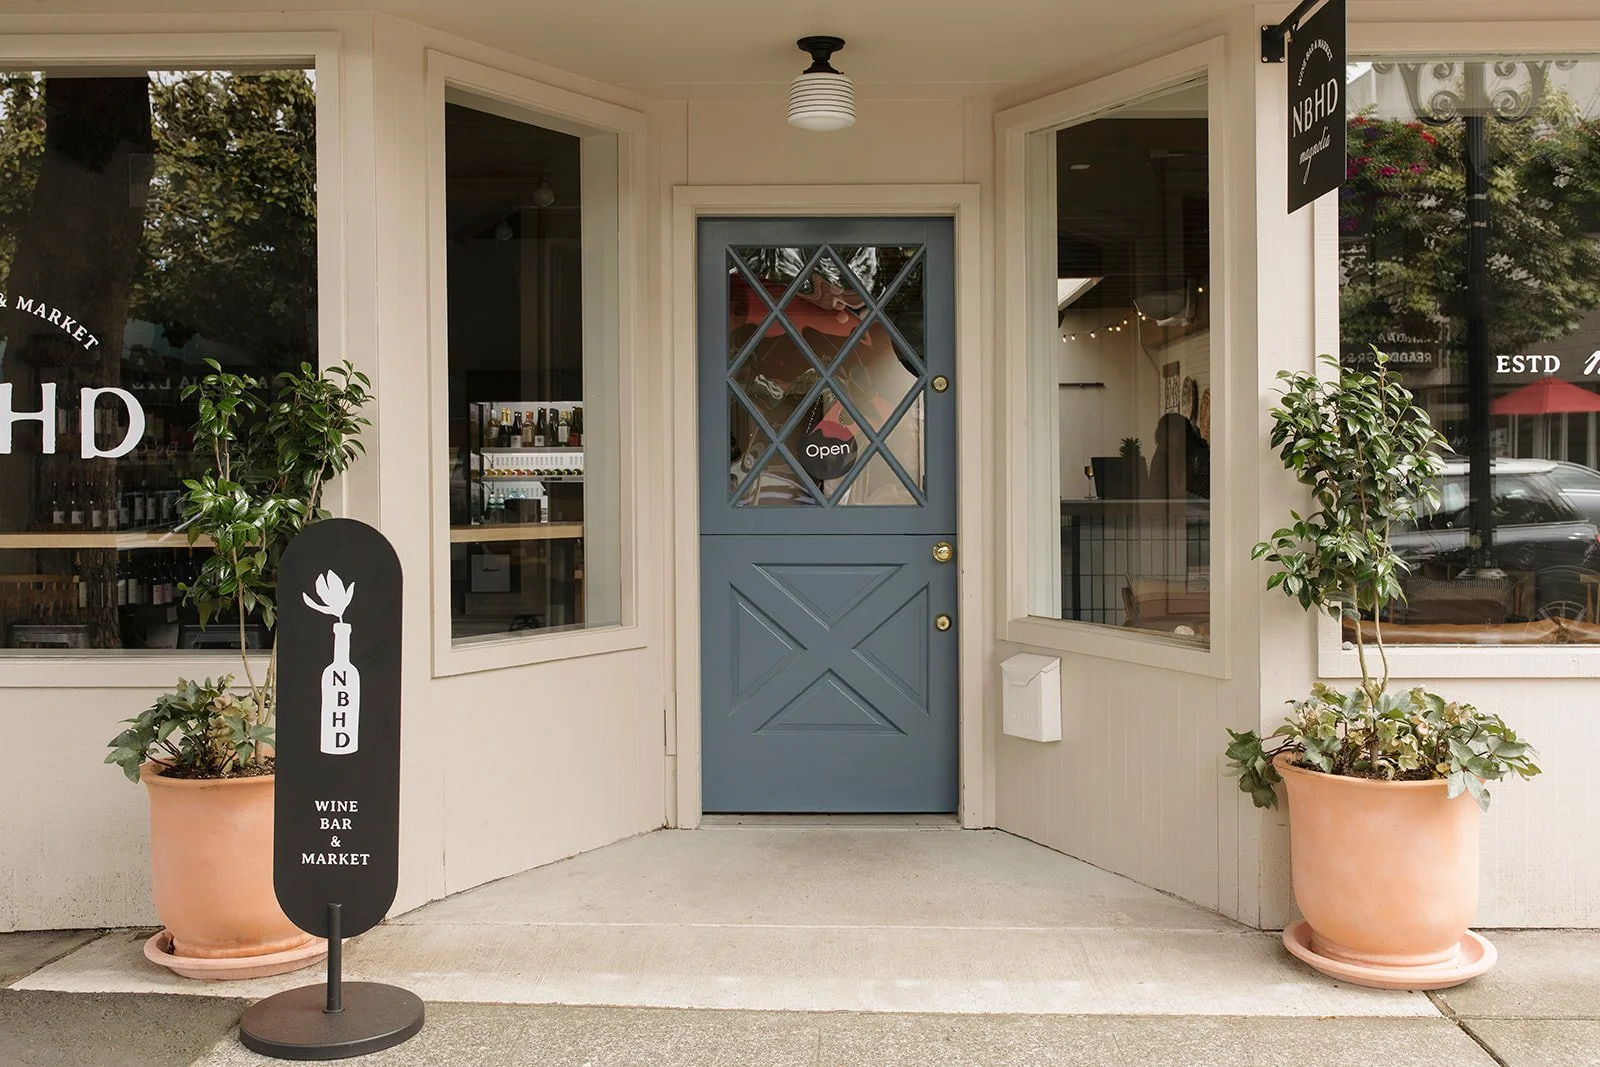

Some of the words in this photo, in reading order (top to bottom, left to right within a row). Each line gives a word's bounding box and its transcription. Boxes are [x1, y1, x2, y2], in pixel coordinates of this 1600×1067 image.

[1293, 78, 1338, 138] NBHD
[1299, 126, 1331, 185] magnolia
[15, 295, 100, 350] MARKET
[1496, 354, 1561, 373] ESTD
[806, 444, 850, 459] Open
[332, 670, 351, 749] NBHD
[314, 800, 359, 812] WINE
[319, 818, 352, 830] BAR
[330, 835, 341, 848] &
[301, 853, 370, 866] MARKET
